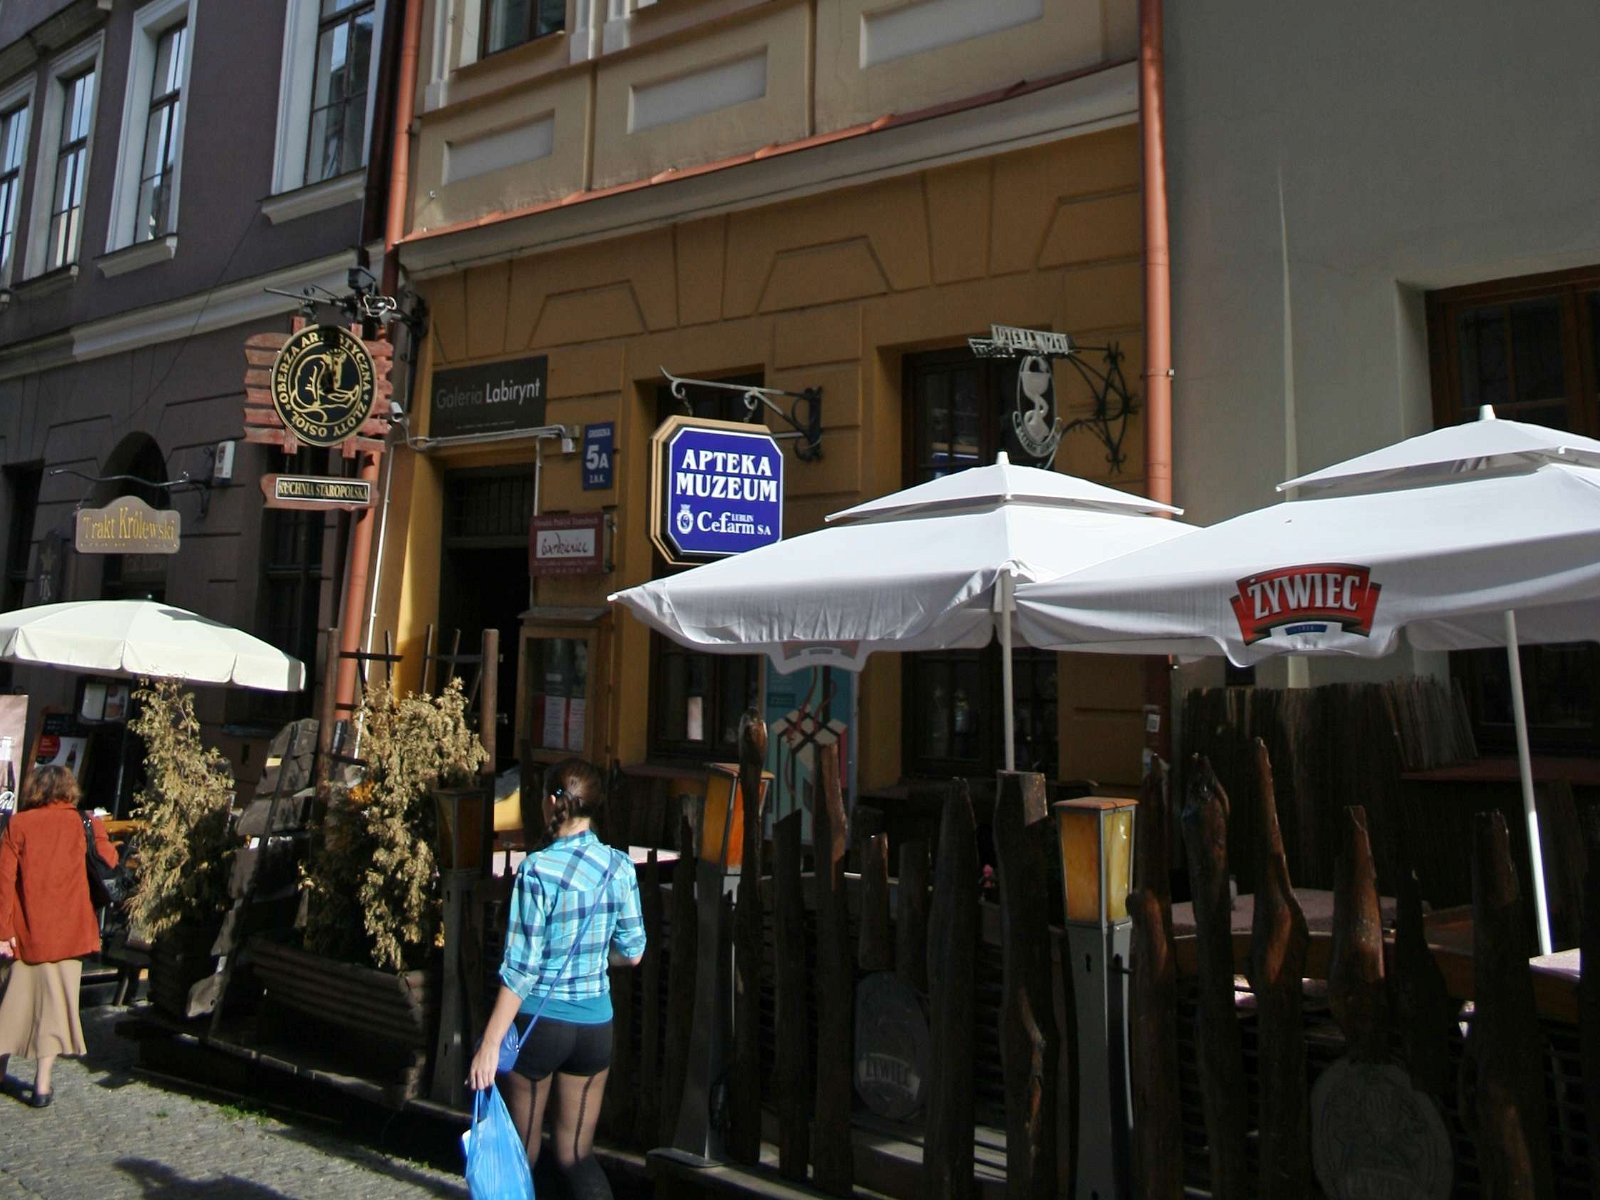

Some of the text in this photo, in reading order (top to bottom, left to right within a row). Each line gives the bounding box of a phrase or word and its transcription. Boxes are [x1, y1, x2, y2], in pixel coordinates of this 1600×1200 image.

[301, 332, 371, 391] ARSTYCZNA
[436, 378, 541, 409] Galeria Labirynt
[586, 444, 609, 470] 5A
[682, 449, 772, 476] APTEKA
[278, 481, 368, 499] KUCHNIA STAROPOLSKA
[676, 472, 777, 502] MUZEUM
[83, 507, 175, 539] Trakt Królewski
[697, 511, 771, 535] Cefarm SA
[731, 513, 754, 522] LUBLIN
[1247, 573, 1360, 620] ŻYWIEC
